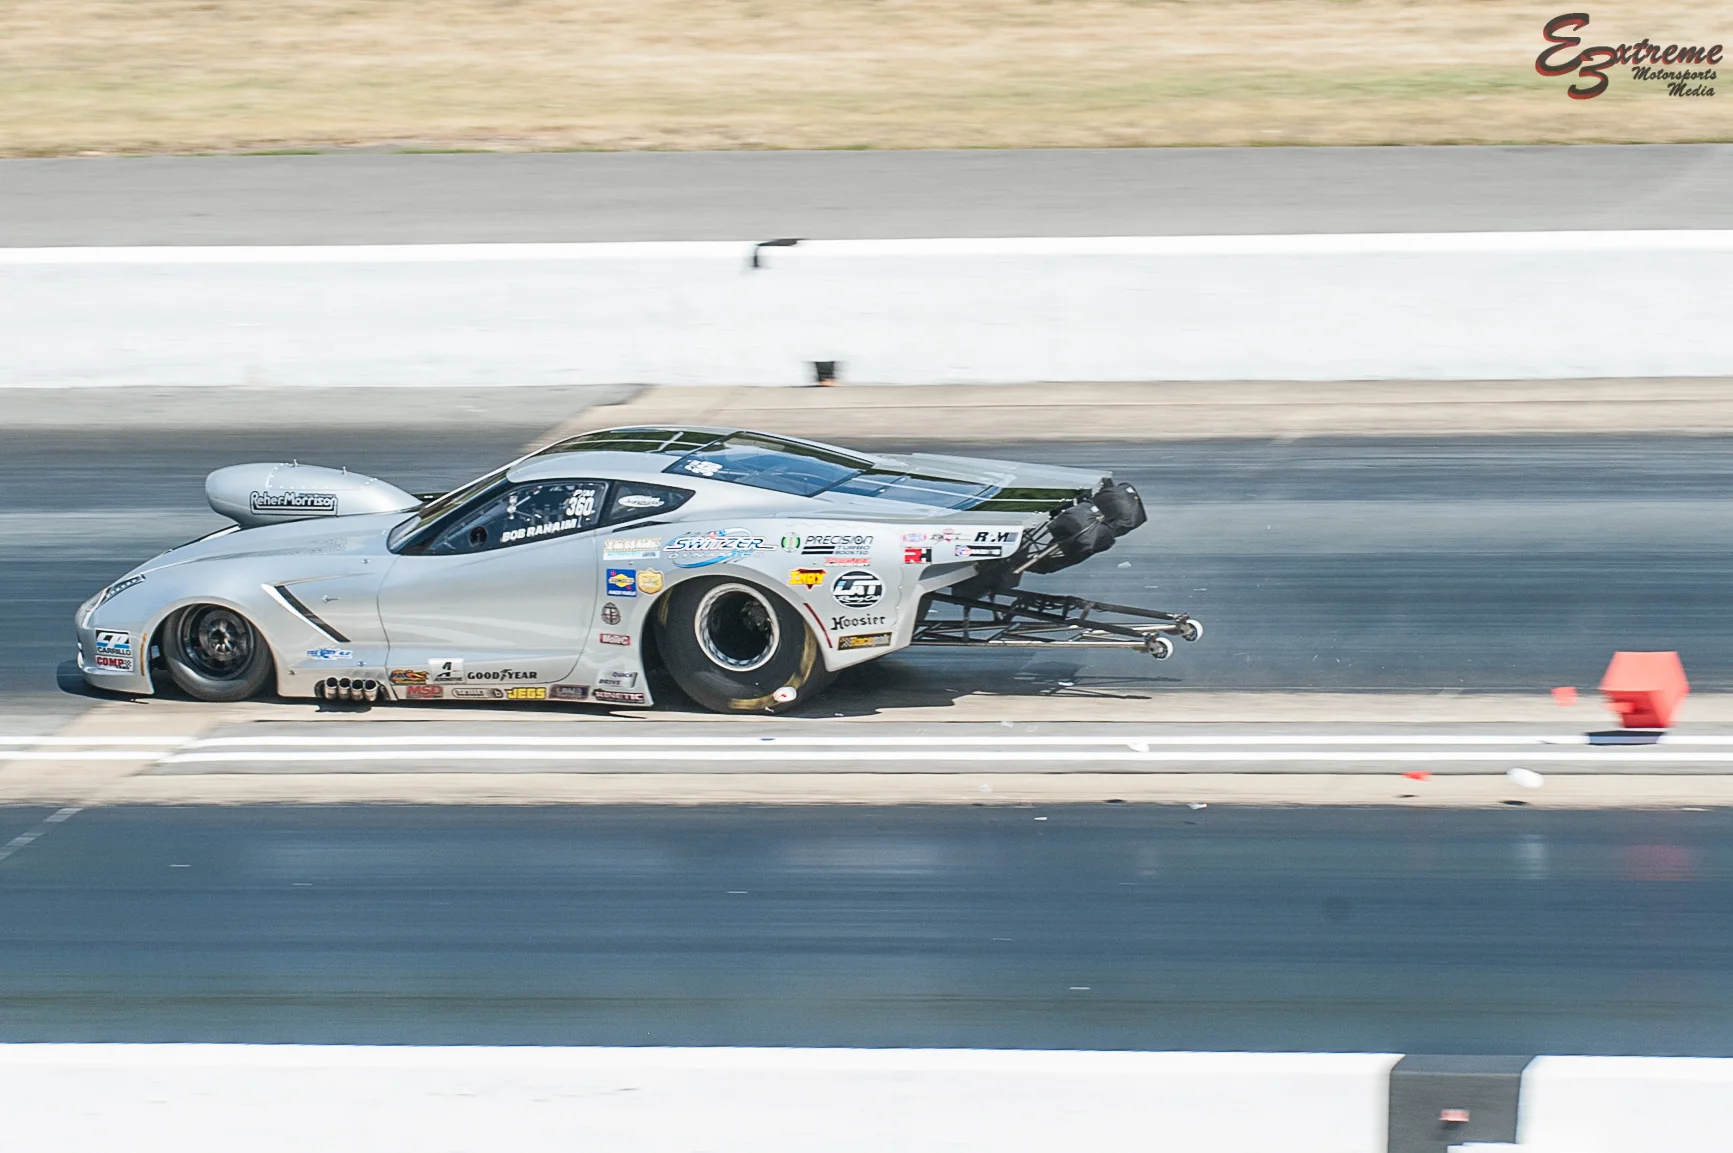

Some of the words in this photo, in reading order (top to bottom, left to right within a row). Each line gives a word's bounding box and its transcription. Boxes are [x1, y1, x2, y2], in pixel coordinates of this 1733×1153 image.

[566, 497, 594, 516] 360
[502, 528, 526, 542] BOB
[527, 518, 577, 537] RAHAIM
[663, 536, 778, 551] SWITZER
[833, 580, 882, 596] LAT
[831, 613, 886, 630] Hoosier
[96, 657, 124, 667] COMP
[408, 685, 443, 695] MSD
[507, 687, 546, 699] JEGS
